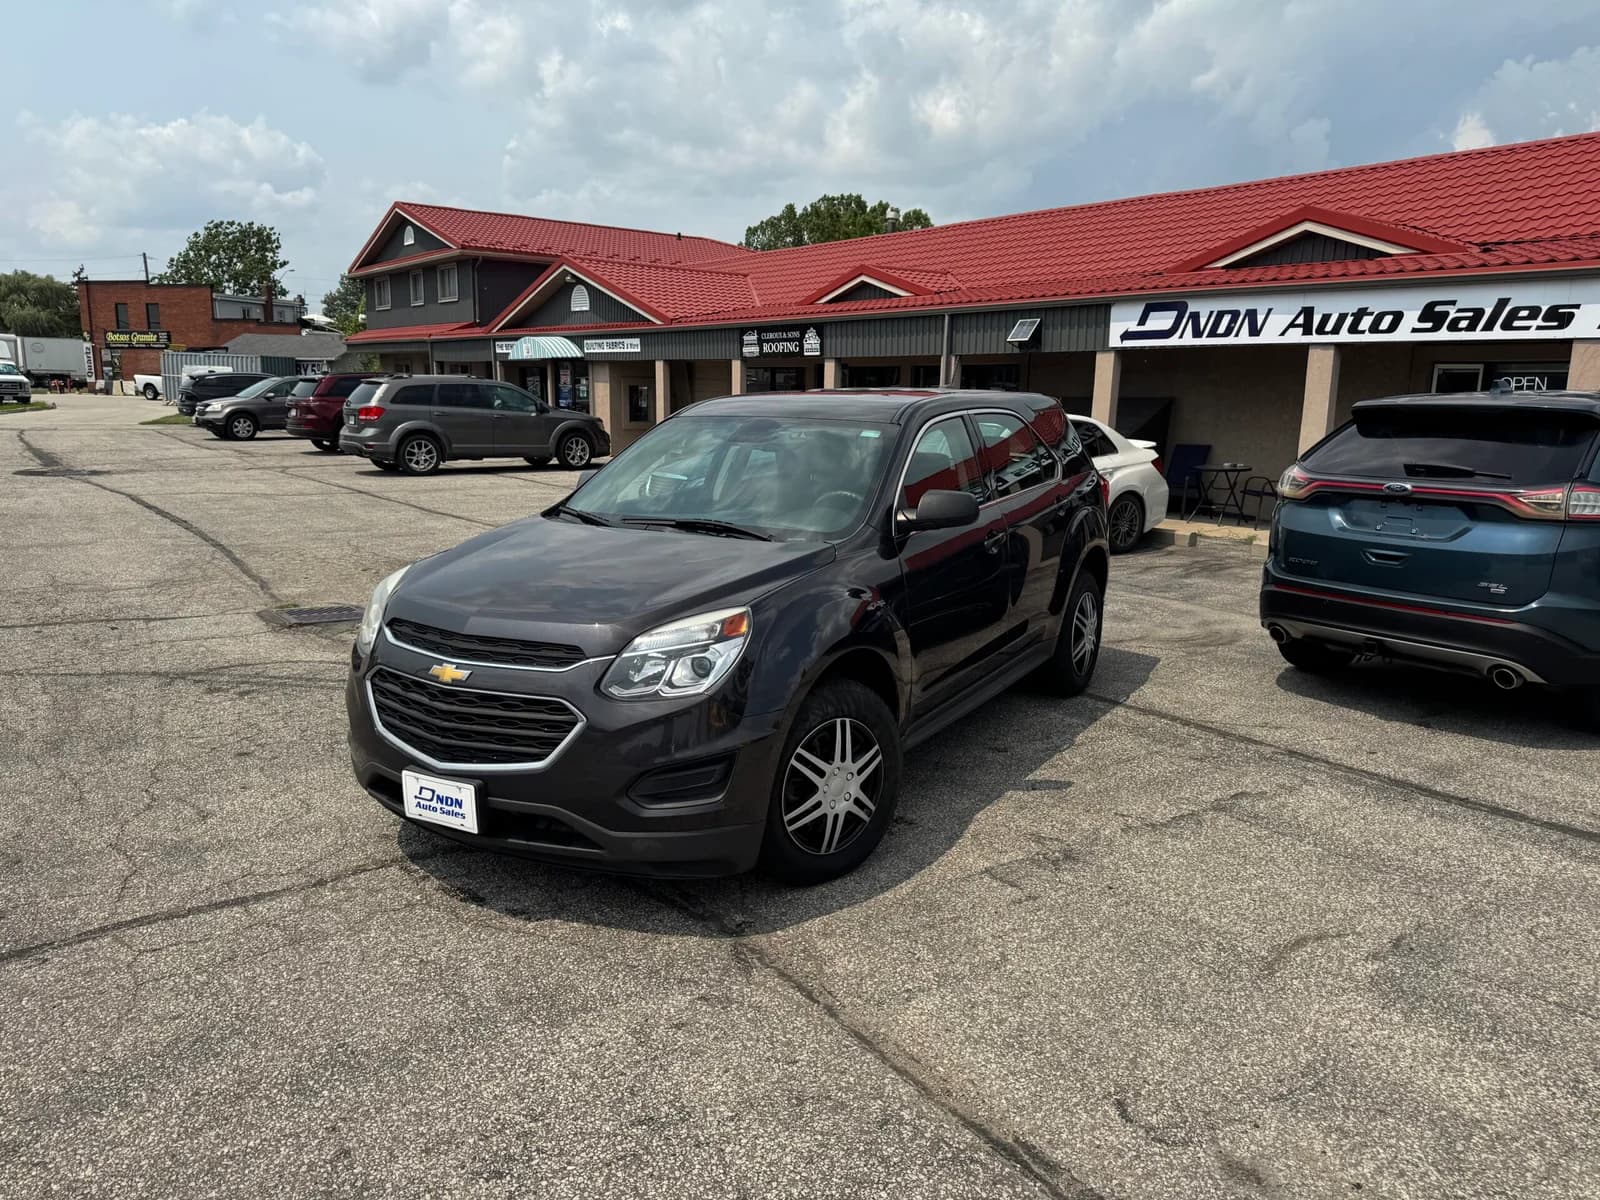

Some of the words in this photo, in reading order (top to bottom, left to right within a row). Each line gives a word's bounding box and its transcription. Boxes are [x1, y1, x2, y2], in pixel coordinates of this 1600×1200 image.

[1119, 300, 1273, 344] DNDN
[1278, 306, 1404, 336] Auto
[1410, 297, 1582, 333] Sales
[131, 331, 158, 344] Granite
[762, 341, 800, 353] ROOFING
[84, 346, 94, 378] Quartz
[414, 785, 463, 809] DNDN
[415, 801, 438, 813] Auto
[439, 806, 466, 820] Sales
